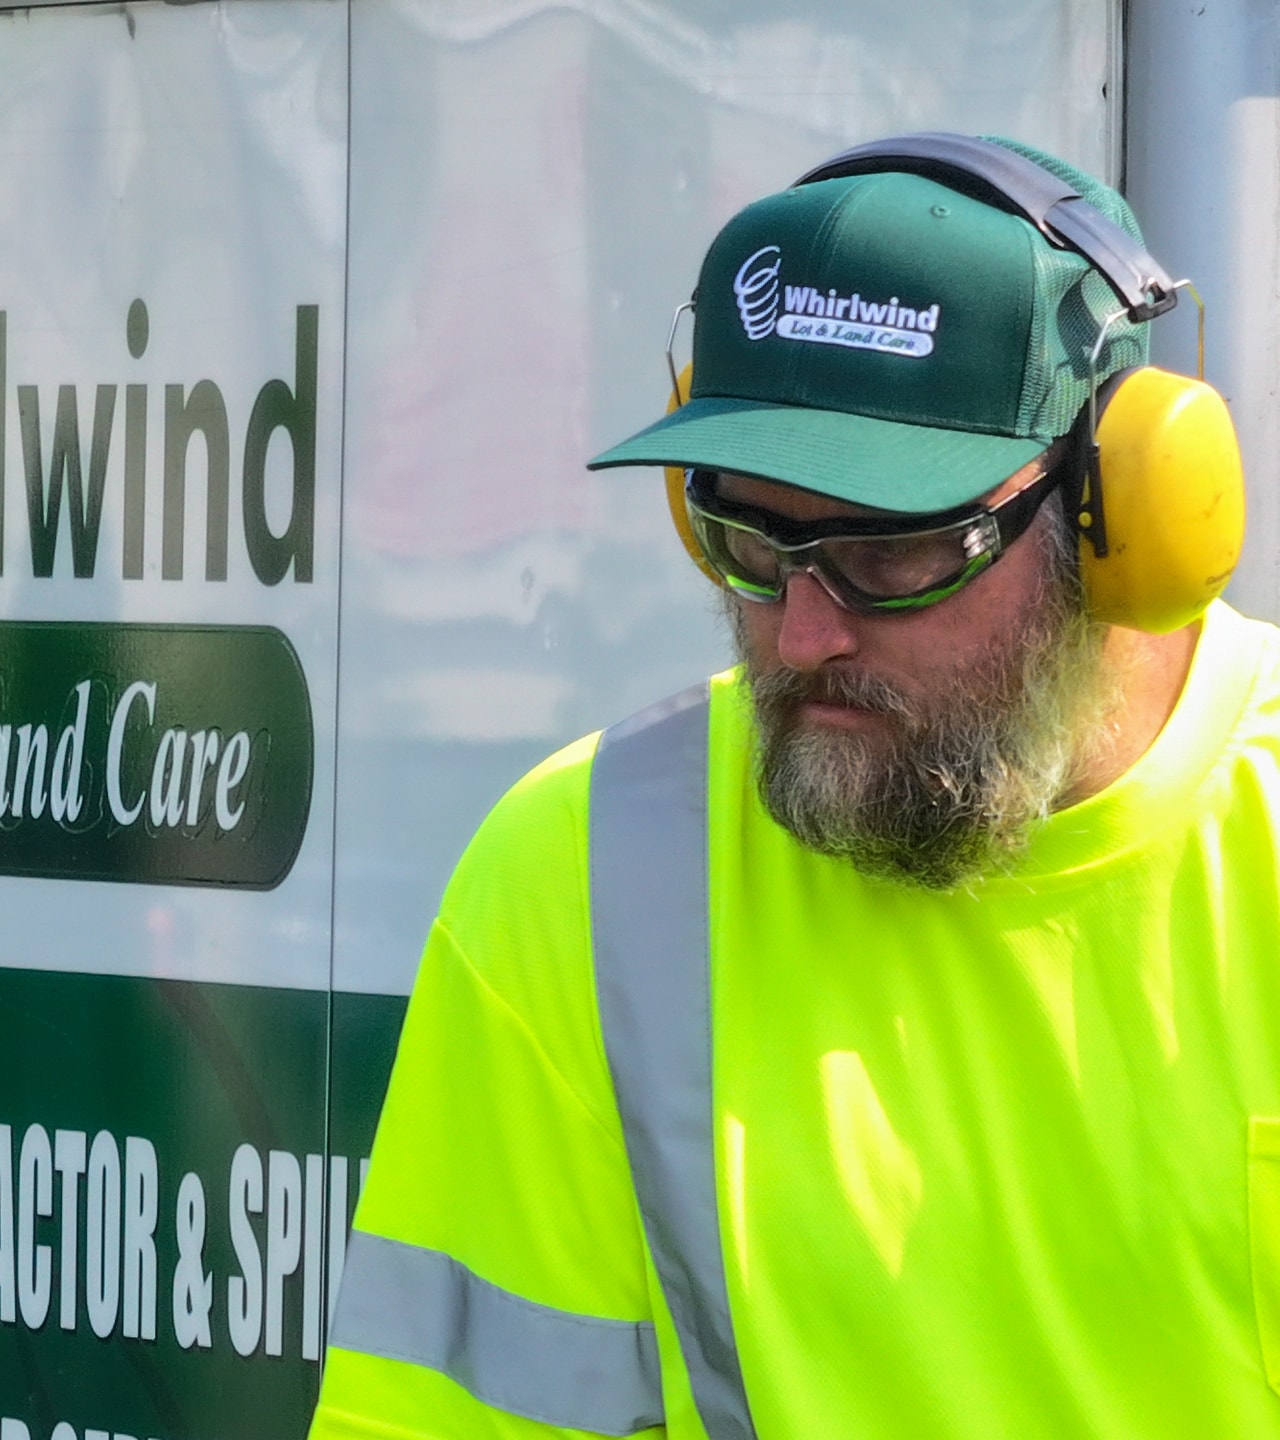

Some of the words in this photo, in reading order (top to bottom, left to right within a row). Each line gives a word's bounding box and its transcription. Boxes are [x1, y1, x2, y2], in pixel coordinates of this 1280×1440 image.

[784, 284, 940, 332] Whirlwind
[106, 680, 251, 831] Care
[172, 1171, 212, 1350] &
